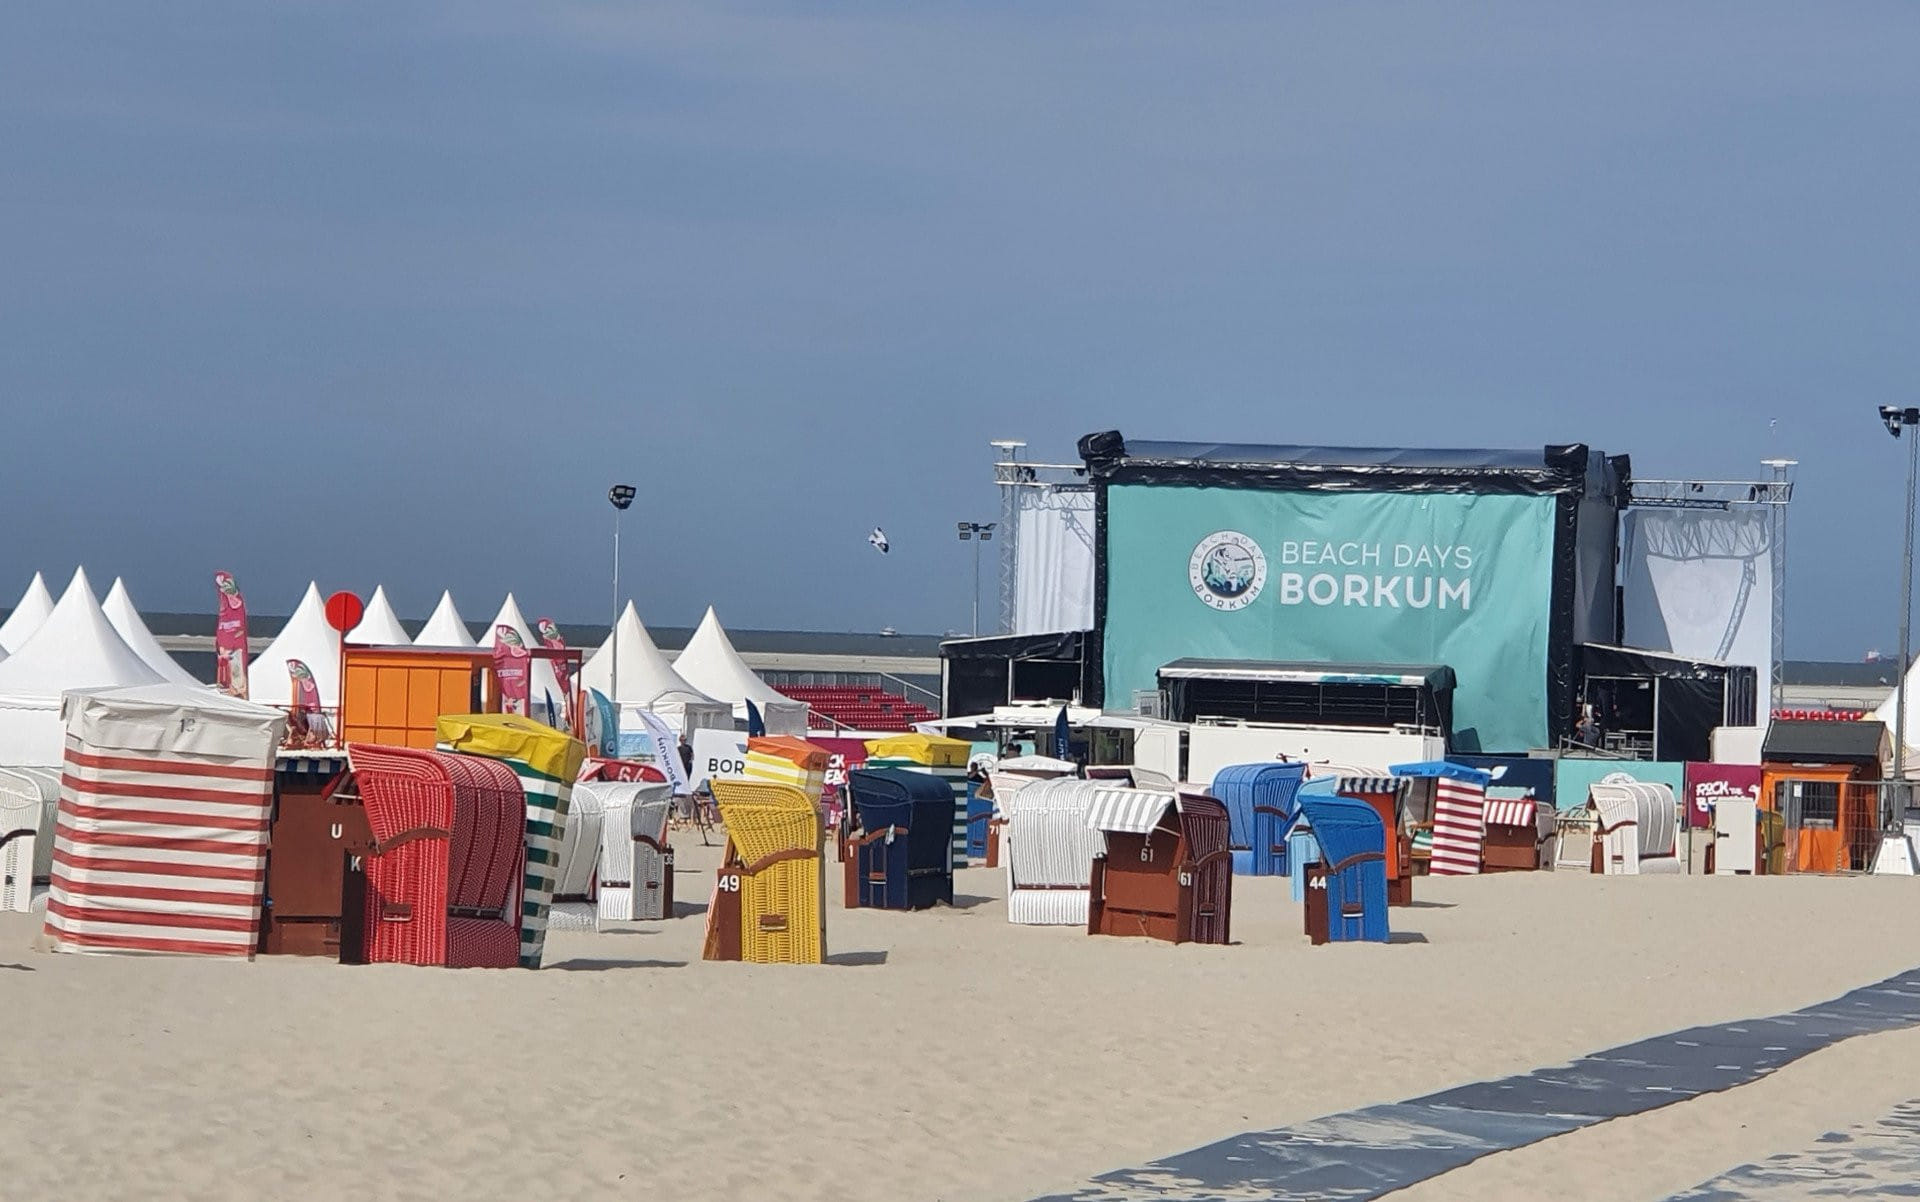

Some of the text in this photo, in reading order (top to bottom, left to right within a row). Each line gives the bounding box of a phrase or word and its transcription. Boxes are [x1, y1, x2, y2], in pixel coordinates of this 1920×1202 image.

[1191, 533, 1228, 571] BEACH
[1281, 541, 1472, 570] BEACH DAYS
[1195, 584, 1259, 609] BORKUM
[1280, 572, 1471, 610] BORKUM
[657, 736, 677, 782] BORKUM
[708, 758, 745, 775] BOR
[1696, 781, 1729, 796] ROCK
[331, 823, 342, 839] U
[989, 825, 999, 835] 71
[350, 855, 362, 872] K
[1140, 848, 1154, 863] 61
[718, 874, 740, 892] 49
[1180, 872, 1192, 886] 61
[1309, 875, 1327, 890] 44
